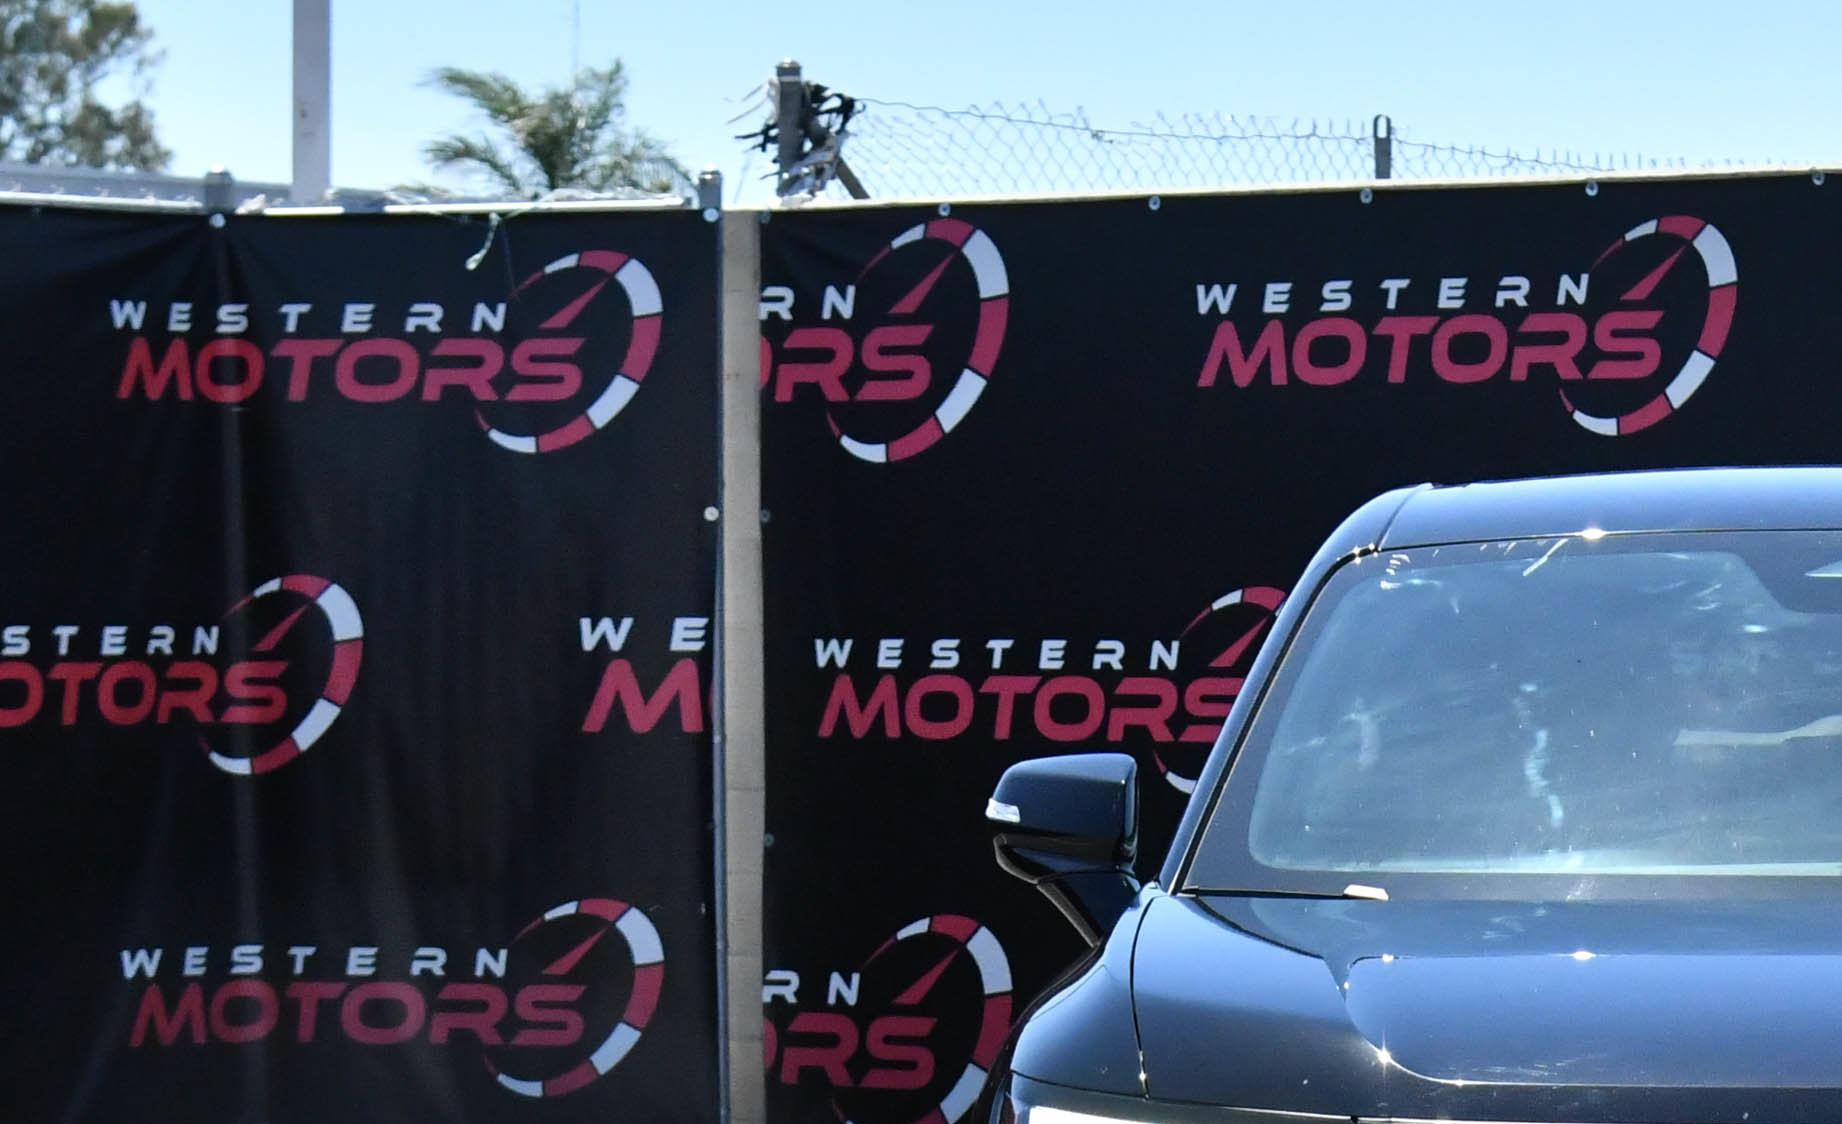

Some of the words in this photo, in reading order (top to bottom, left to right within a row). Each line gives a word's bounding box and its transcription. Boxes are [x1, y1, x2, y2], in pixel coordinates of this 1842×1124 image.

[113, 301, 505, 332] WESTERN
[1197, 274, 1588, 314] WESTERN
[118, 338, 582, 403] MOTORS
[760, 325, 932, 402] RS
[1199, 310, 1663, 387] MOTORS
[816, 639, 1179, 670] WESTERN
[819, 675, 1244, 742] MOTORS
[123, 946, 507, 977] WESTERN
[132, 981, 584, 1045] MOTORS
[765, 1013, 936, 1088] RS
